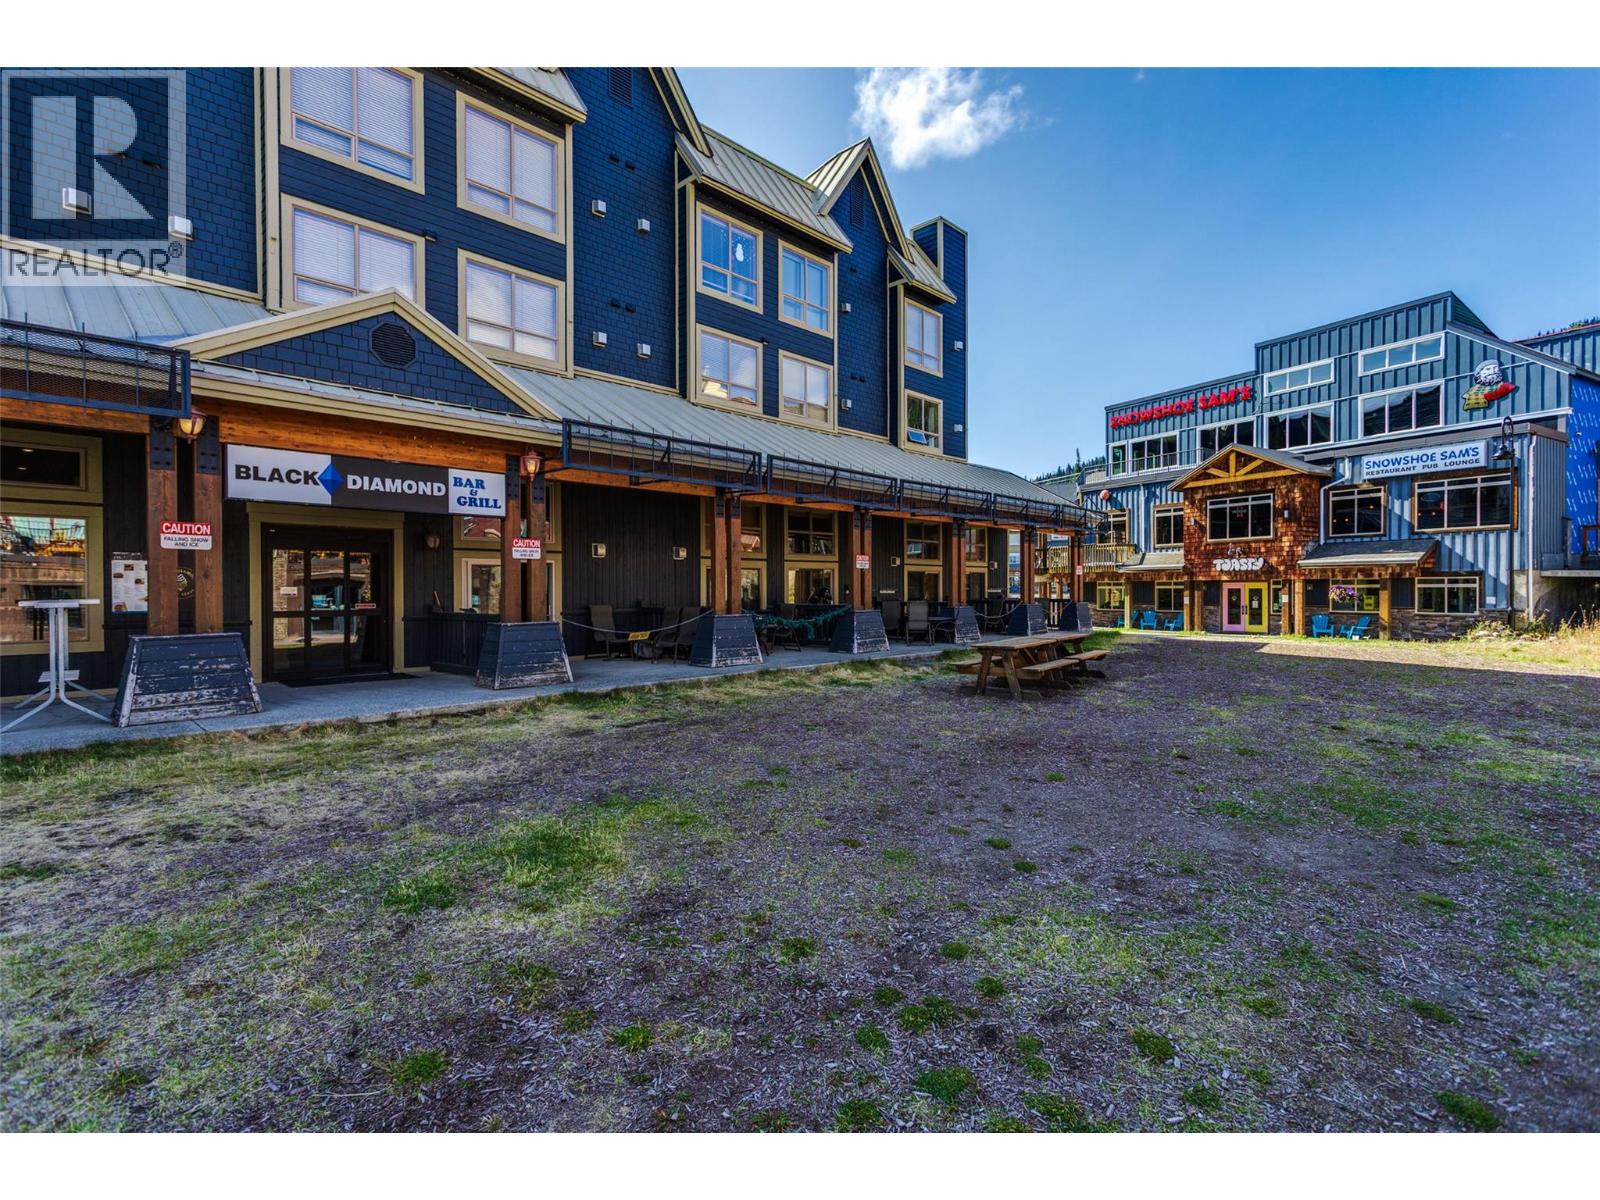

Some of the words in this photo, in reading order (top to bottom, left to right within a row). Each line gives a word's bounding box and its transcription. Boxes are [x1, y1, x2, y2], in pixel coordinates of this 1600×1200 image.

[1110, 398, 1195, 430] SNOWSHOE
[1198, 384, 1252, 410] SAM'S
[1365, 452, 1437, 470] SNOWSHOE
[1440, 446, 1480, 461] SAM'S
[1365, 465, 1417, 476] RESTAURANT
[1444, 457, 1481, 467] LOUNGE
[235, 464, 320, 486] BLACK
[346, 474, 447, 497] DIAMOND
[453, 476, 486, 490] BAR
[456, 496, 501, 509] GRILL
[162, 522, 211, 535] CAUTION
[513, 538, 541, 548] CAUTION
[1212, 557, 1264, 571] TOASTY
